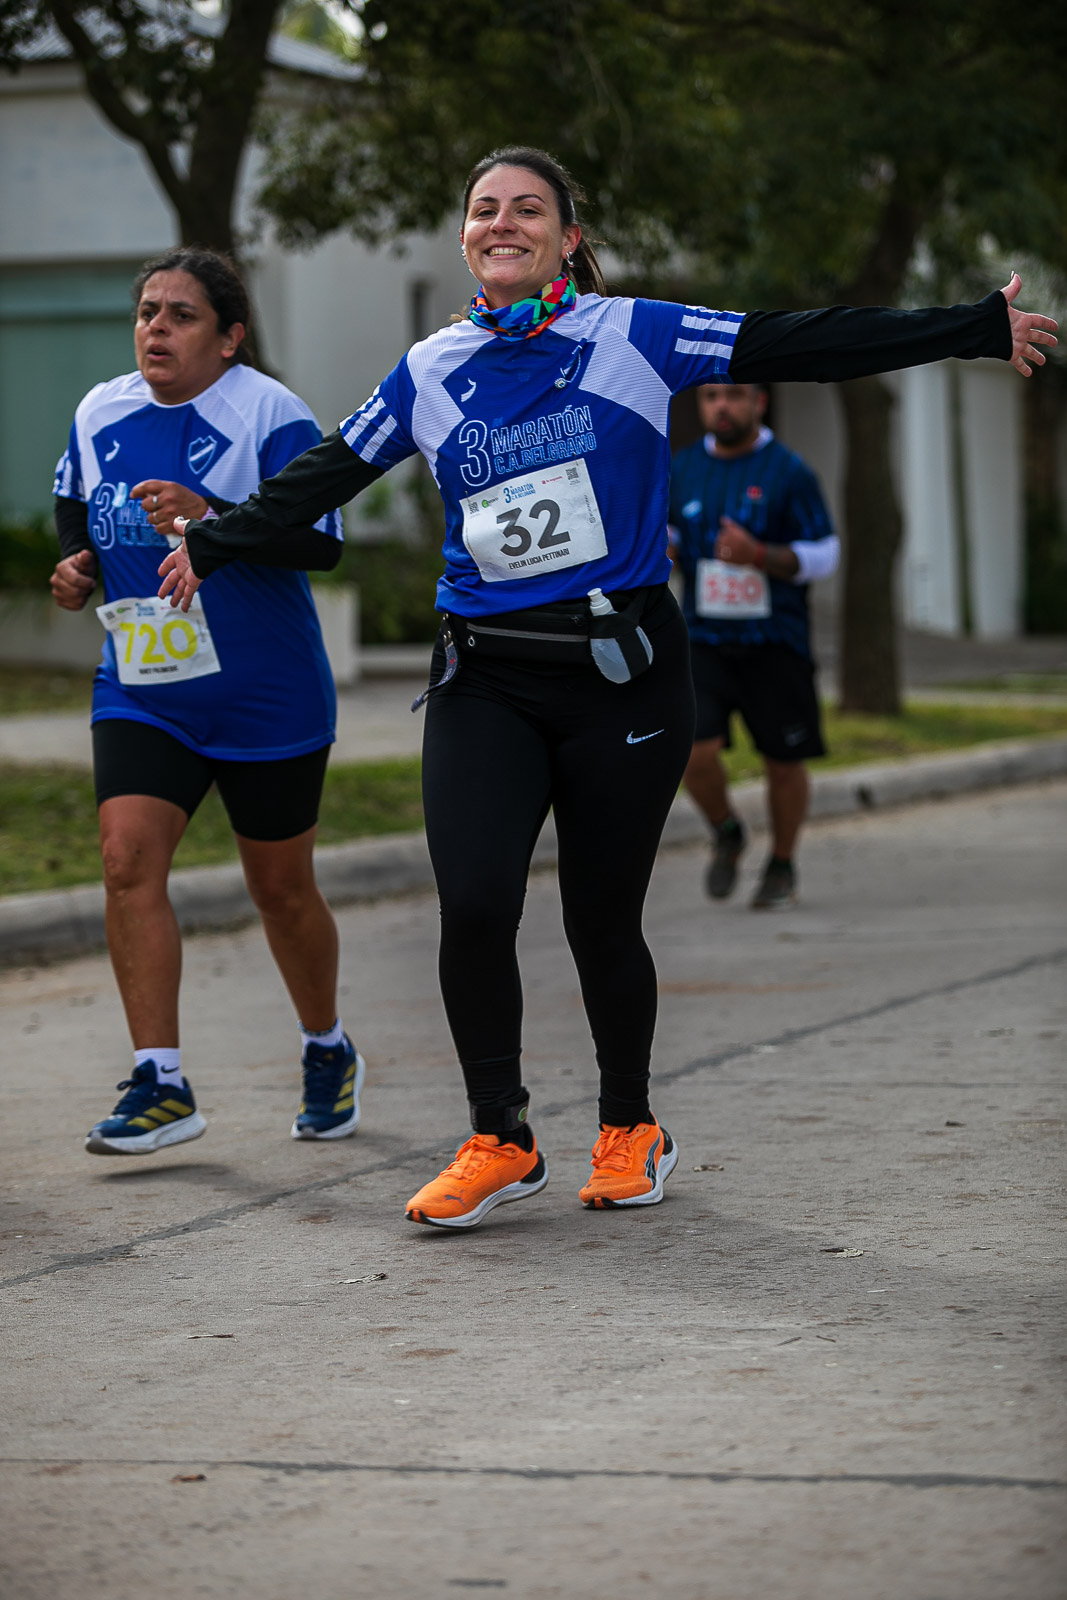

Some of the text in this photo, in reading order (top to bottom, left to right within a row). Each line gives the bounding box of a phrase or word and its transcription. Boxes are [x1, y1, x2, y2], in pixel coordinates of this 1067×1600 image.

[459, 404, 593, 487] 3 MARATÓN
[93, 482, 115, 550] 3
[503, 487, 512, 504] 3
[496, 499, 571, 557] 32
[508, 548, 570, 570] EVELIN LUCIA PETTINARI
[119, 619, 198, 664] 720
